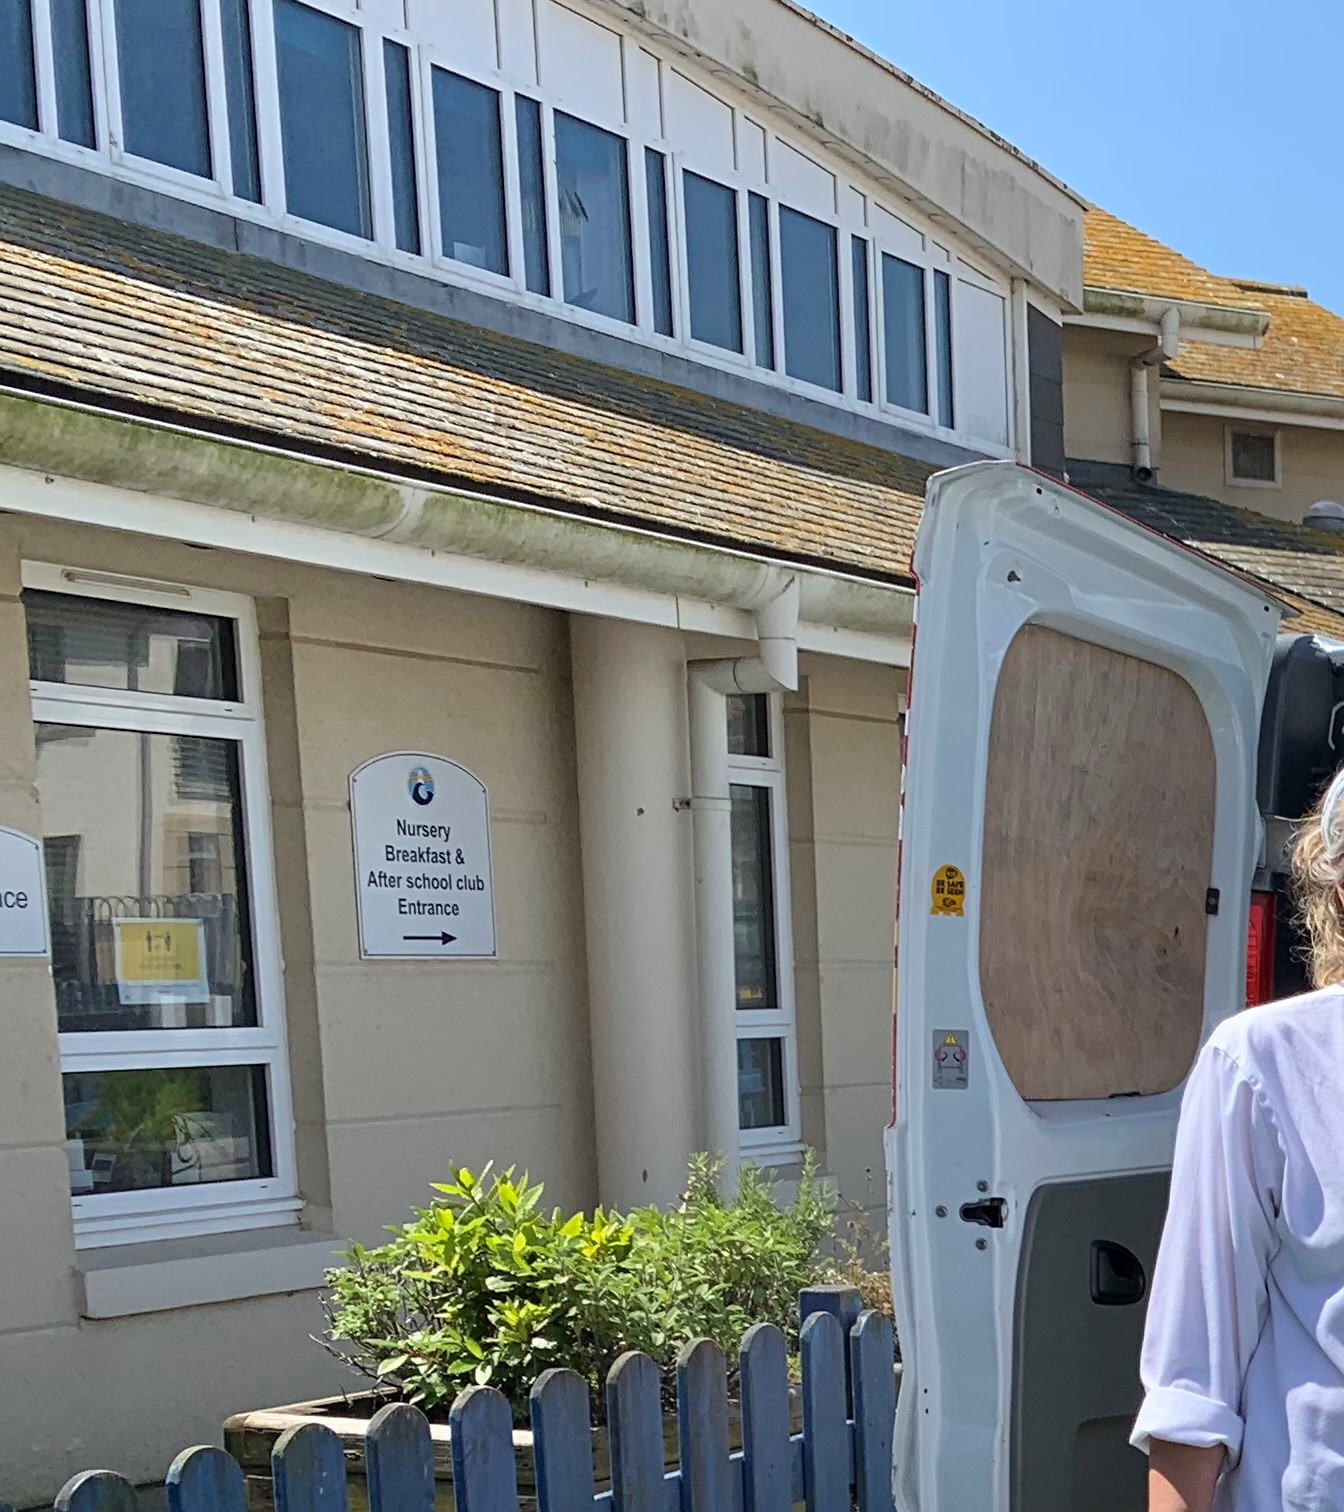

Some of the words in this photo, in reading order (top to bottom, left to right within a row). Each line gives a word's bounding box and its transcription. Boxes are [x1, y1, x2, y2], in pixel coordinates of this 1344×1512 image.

[396, 819, 450, 843] Nursery
[385, 845, 451, 865] Breakfast
[455, 848, 465, 865] &
[367, 871, 402, 889] After
[406, 874, 452, 891] school
[456, 875, 485, 891] club
[398, 898, 460, 916] Entrance
